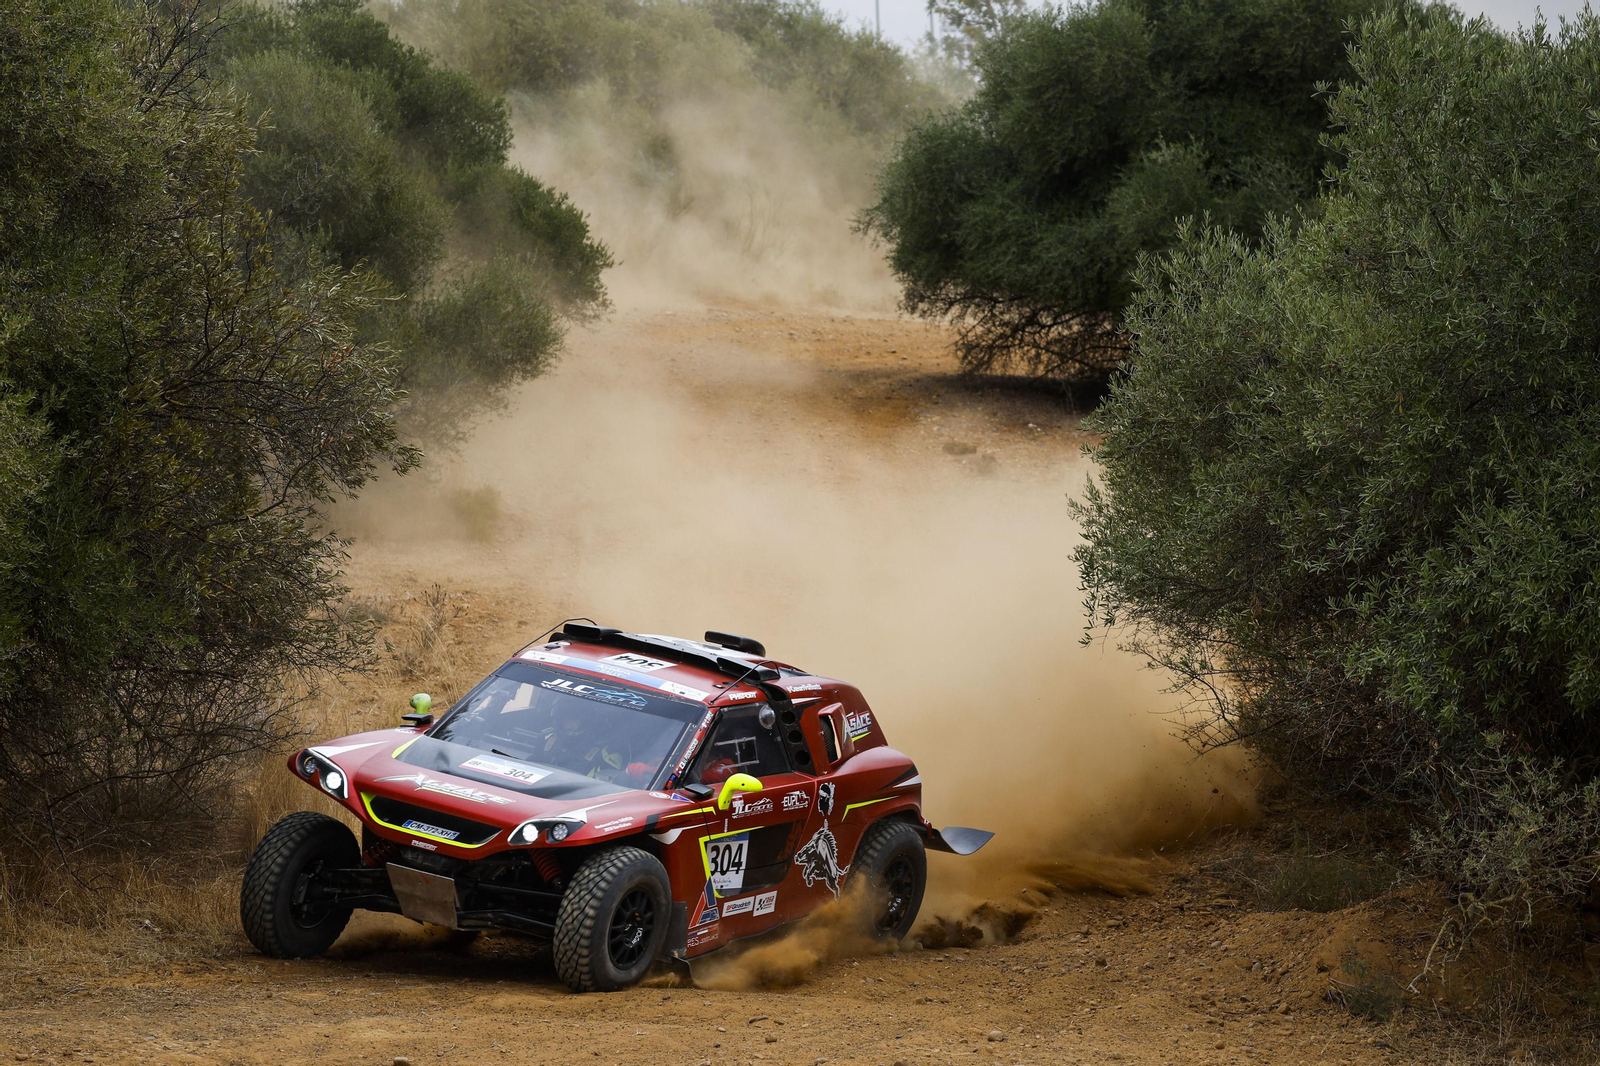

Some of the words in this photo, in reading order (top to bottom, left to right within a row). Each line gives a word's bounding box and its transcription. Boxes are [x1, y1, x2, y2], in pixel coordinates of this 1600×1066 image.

[614, 655, 664, 669] 304
[503, 768, 534, 780] 304
[783, 794, 800, 807] EUPL
[409, 821, 452, 837] CM-372-XH
[710, 843, 744, 876] 304
[726, 901, 751, 911] BFGoodrich
